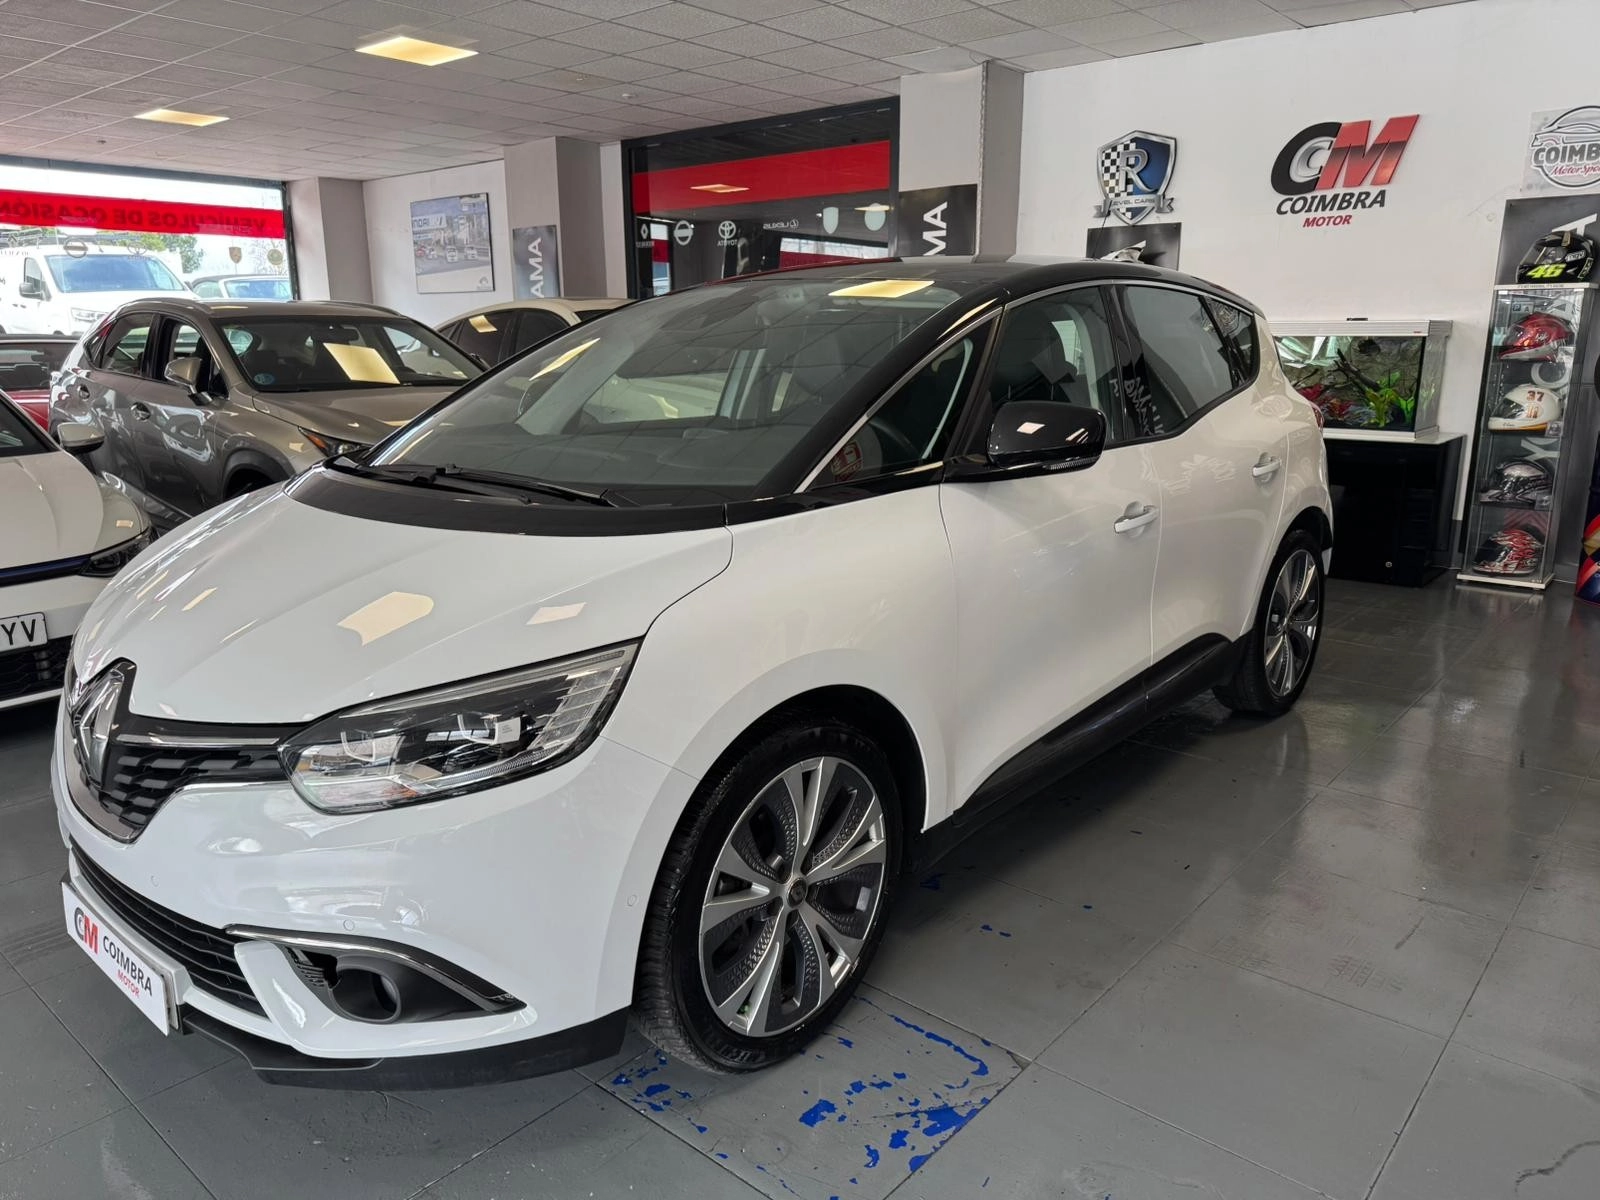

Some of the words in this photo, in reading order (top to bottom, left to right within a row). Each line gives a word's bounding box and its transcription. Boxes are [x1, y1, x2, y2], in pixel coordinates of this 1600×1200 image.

[1277, 189, 1386, 215] COIMBRA
[1303, 215, 1352, 228] MOTOR
[1527, 263, 1567, 279] 46
[1527, 390, 1544, 401] 37
[1, 619, 36, 646] YV
[103, 935, 153, 996] COIMBRA
[117, 969, 140, 999] MOTOR
